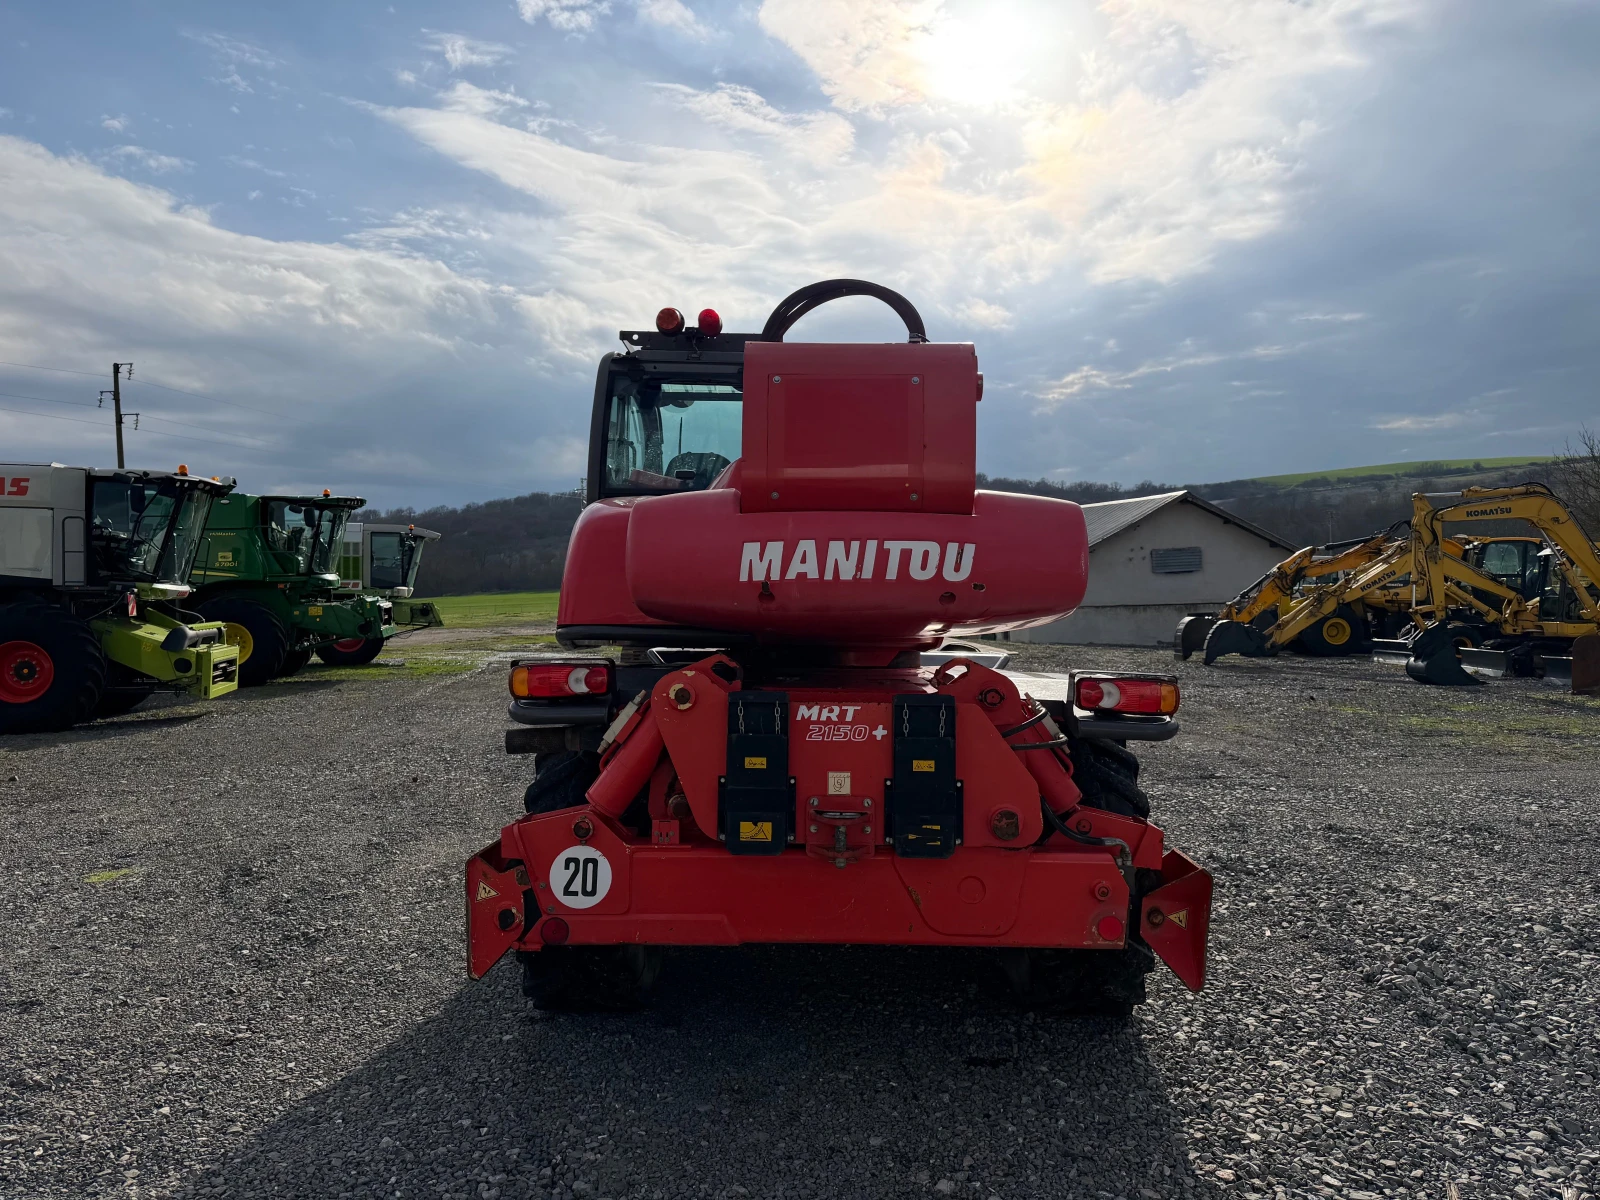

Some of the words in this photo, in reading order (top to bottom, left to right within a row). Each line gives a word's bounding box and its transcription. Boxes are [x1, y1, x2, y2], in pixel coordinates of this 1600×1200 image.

[0, 477, 30, 496] S
[1466, 506, 1512, 518] KOMATSU
[739, 540, 976, 582] MANITOU
[1360, 570, 1397, 592] KOMATSU
[796, 705, 861, 722] MRT
[563, 857, 599, 897] 20
